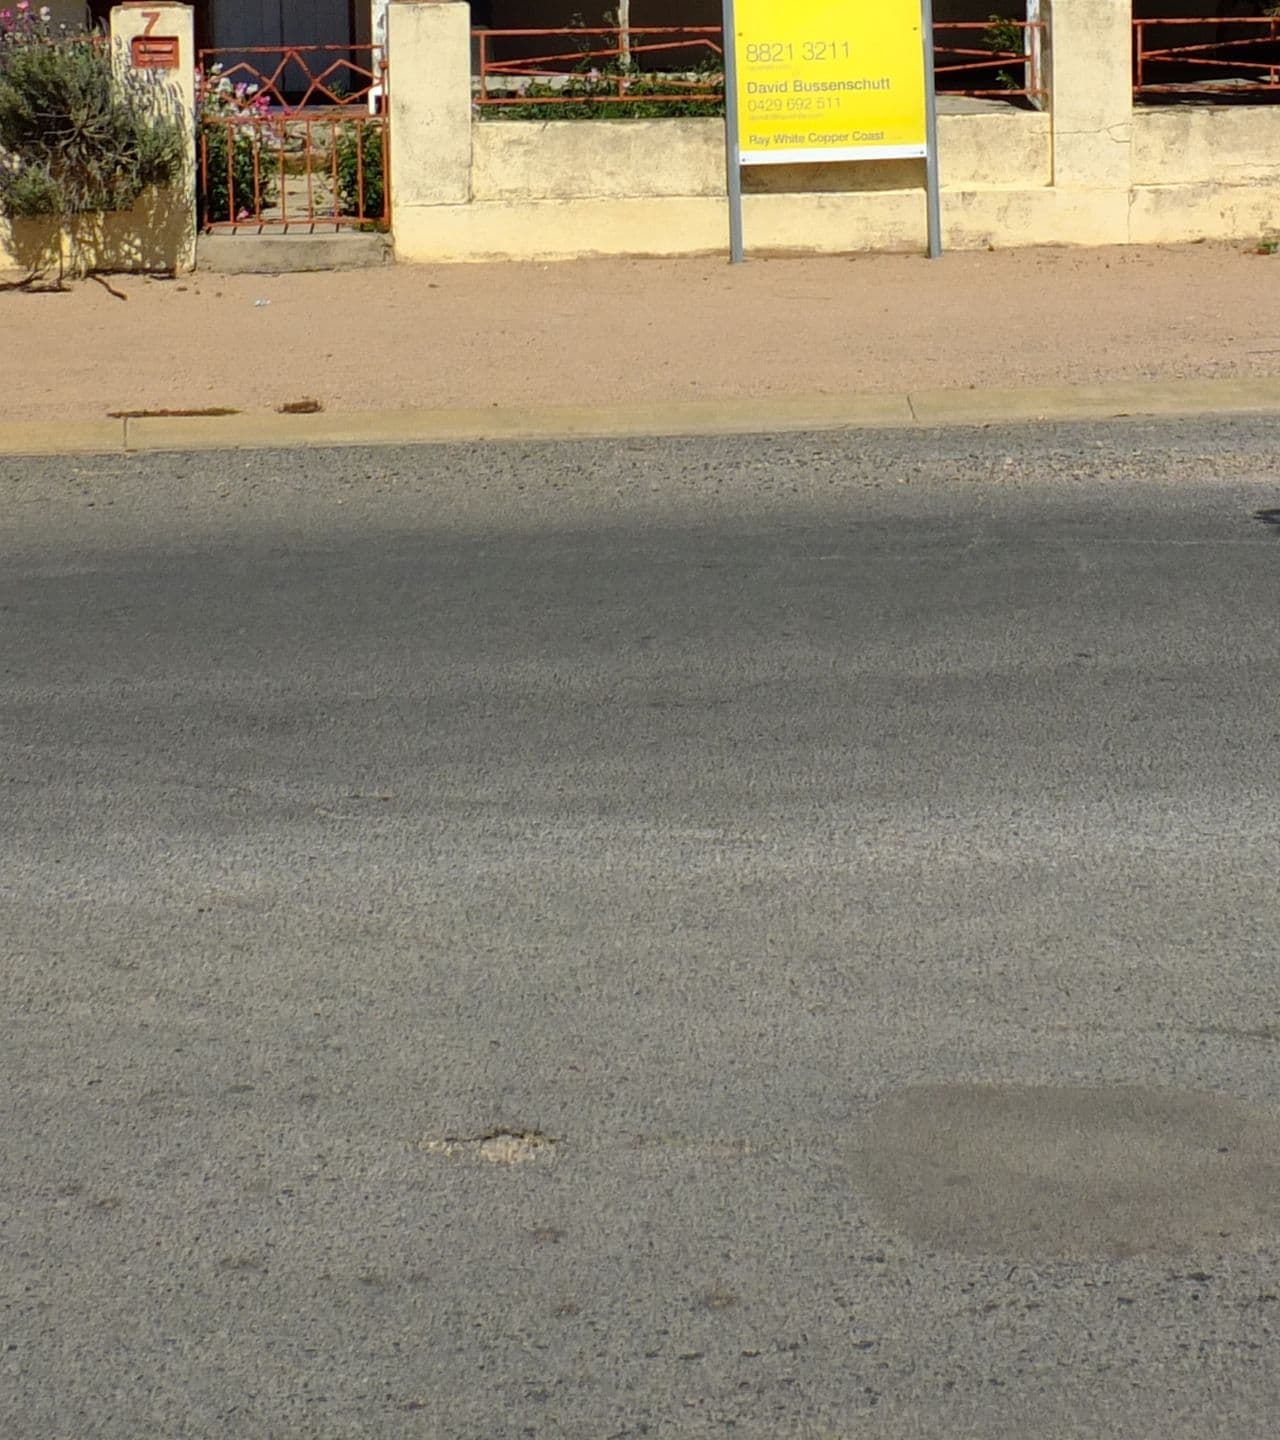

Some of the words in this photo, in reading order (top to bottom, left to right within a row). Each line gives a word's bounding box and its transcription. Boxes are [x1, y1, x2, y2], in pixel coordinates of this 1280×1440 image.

[141, 11, 161, 38] 7
[745, 42, 794, 62] 8821
[802, 40, 850, 61] 3211
[747, 80, 788, 94] David
[793, 78, 890, 93] Bussenschutt
[747, 98, 782, 112] 0429
[787, 97, 812, 111] 692
[749, 134, 770, 147] Ray
[773, 133, 805, 144] White
[808, 132, 849, 144] Copper
[852, 130, 884, 141] Coast
